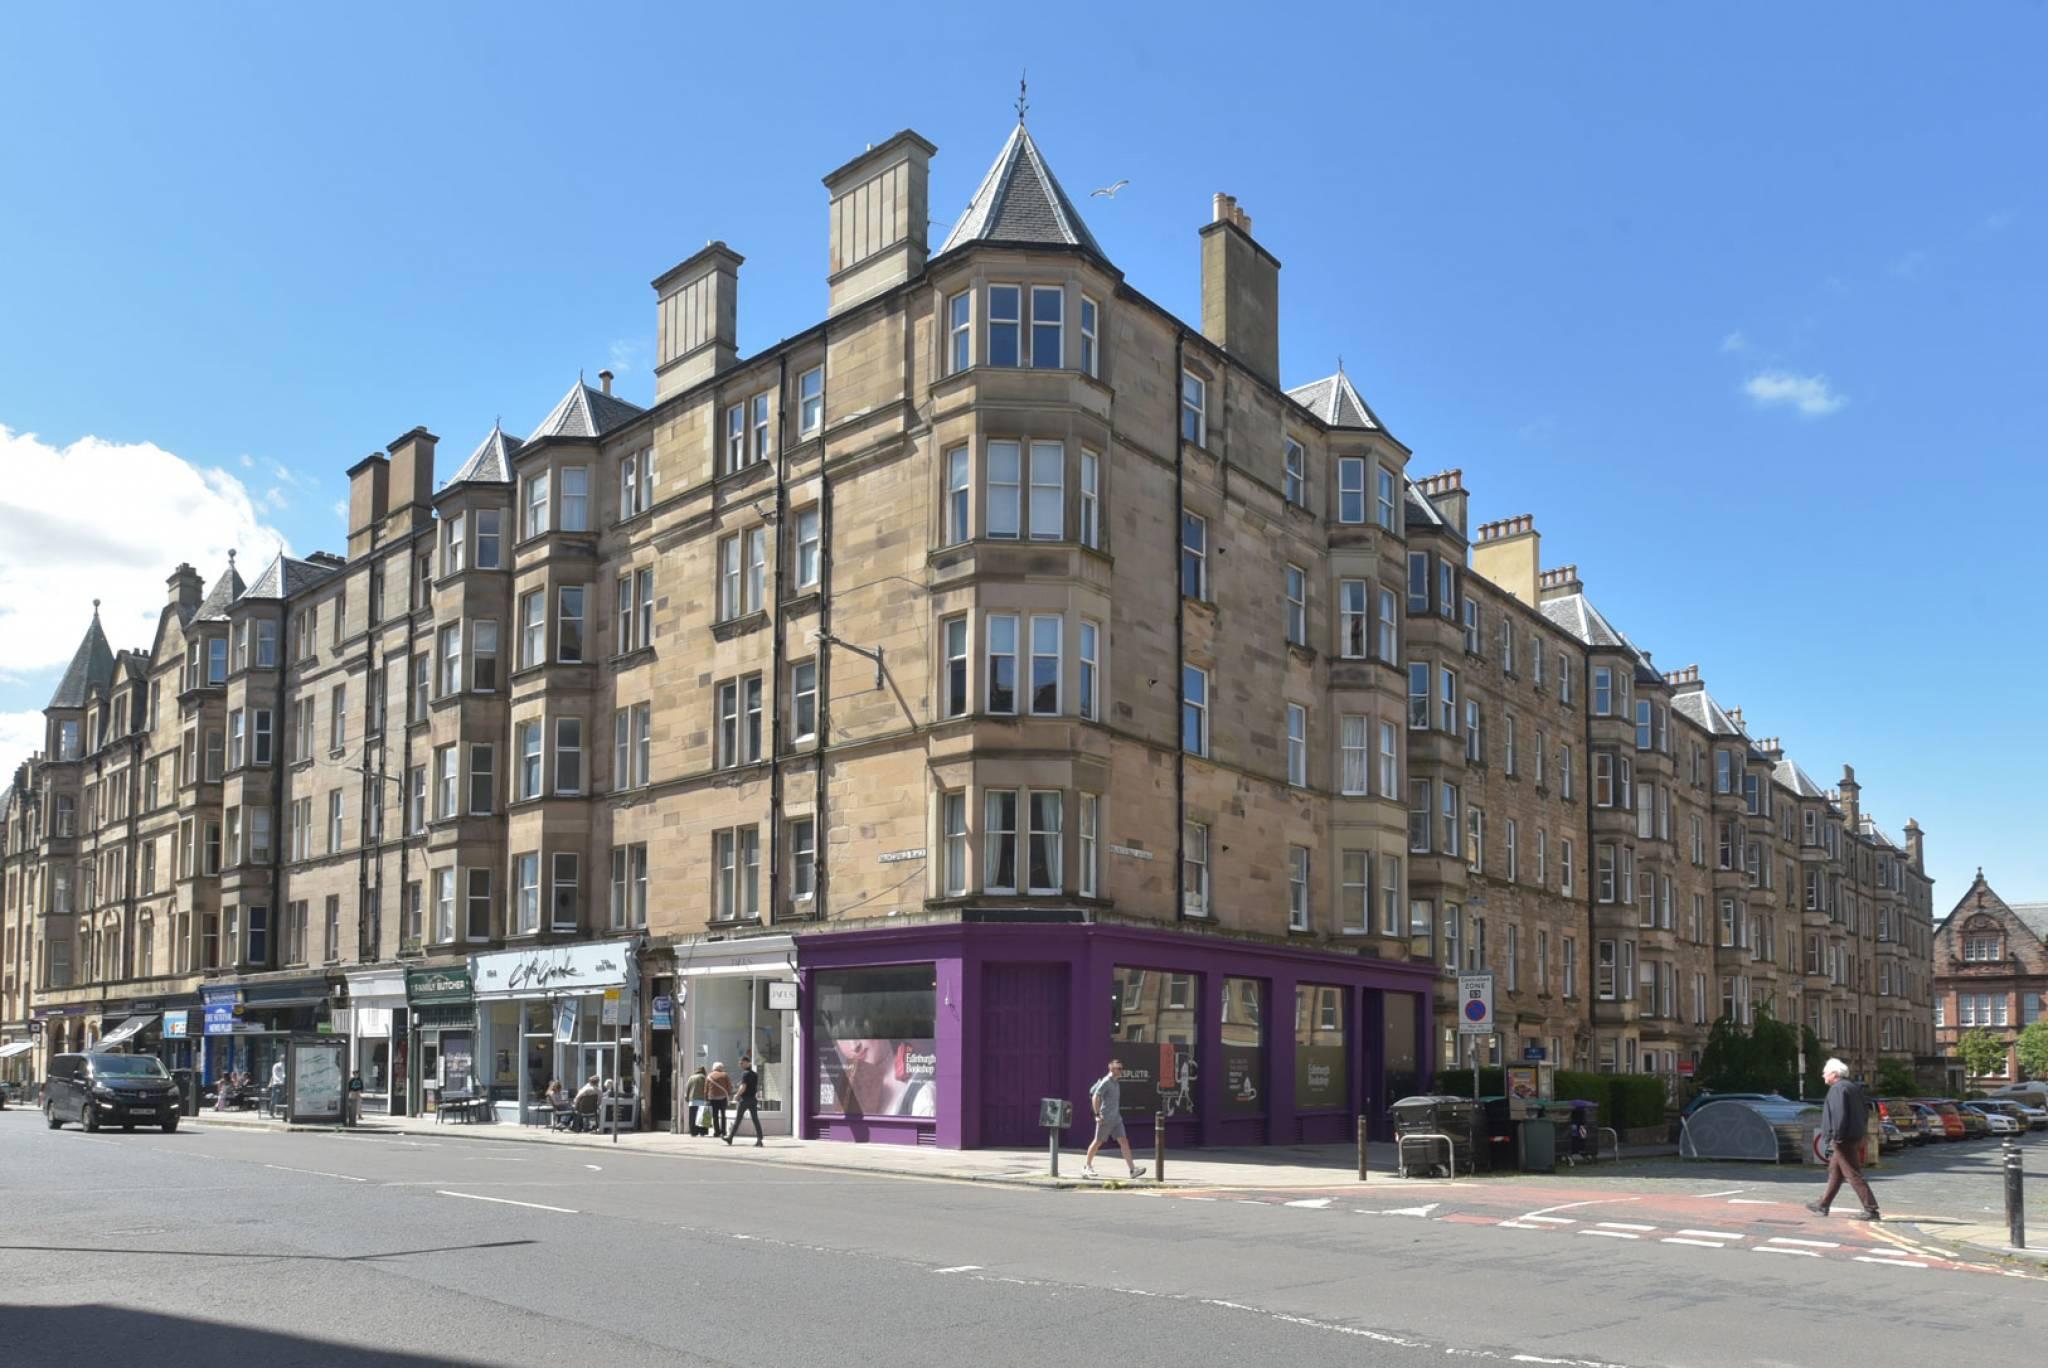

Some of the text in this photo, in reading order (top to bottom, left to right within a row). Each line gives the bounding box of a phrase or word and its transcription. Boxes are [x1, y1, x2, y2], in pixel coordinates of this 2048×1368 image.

[415, 980, 465, 992] FAMILY BUTCHER
[906, 1052, 936, 1065] Edinburgh
[906, 1063, 934, 1075] Bookshop
